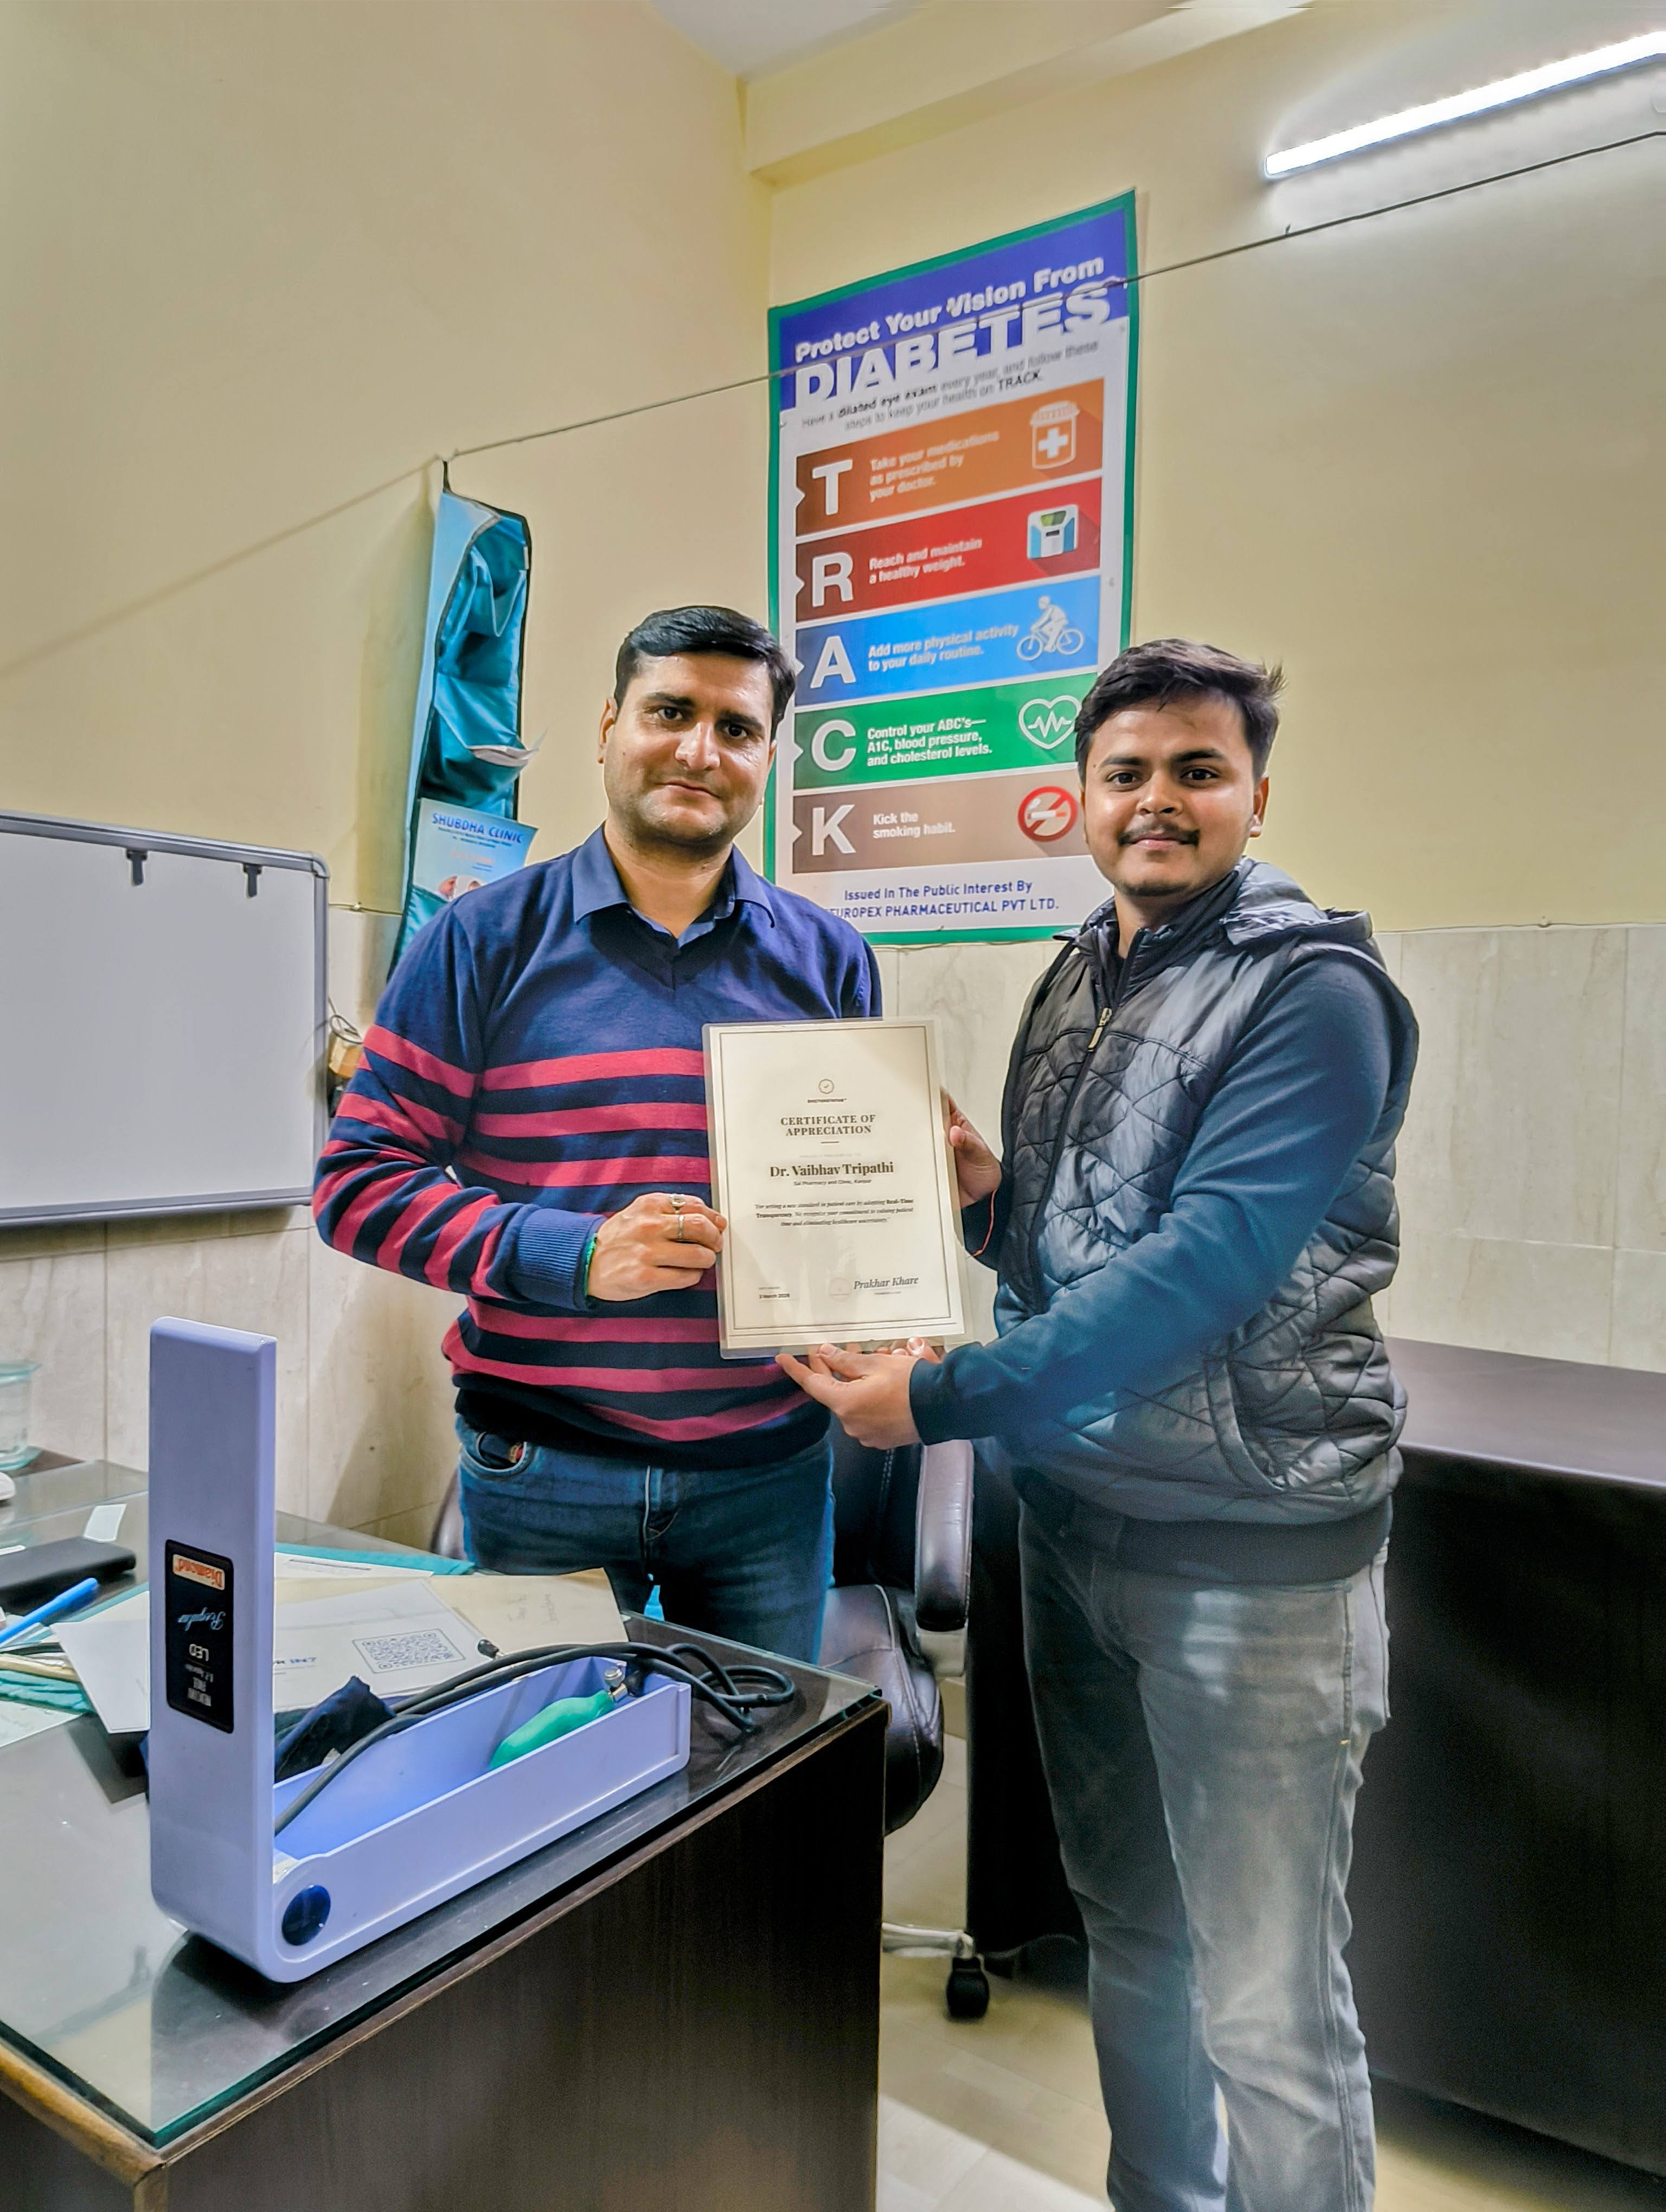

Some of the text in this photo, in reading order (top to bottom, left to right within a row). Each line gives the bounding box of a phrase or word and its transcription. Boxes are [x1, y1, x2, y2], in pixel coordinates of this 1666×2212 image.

[795, 256, 1104, 363] Protect Your Vision From
[795, 280, 1111, 411] DIABETES
[837, 398, 877, 419] dilated
[881, 394, 901, 410] eye
[905, 384, 938, 402] exam
[941, 376, 975, 394] every
[1003, 360, 1025, 375] and
[1028, 349, 1061, 368] follow
[1065, 341, 1098, 358] these
[875, 411, 887, 423] to
[889, 404, 913, 421] keep
[915, 397, 940, 415] your
[942, 386, 977, 406] health
[979, 384, 995, 397] on
[870, 432, 1000, 472] Take your medications
[870, 455, 964, 486] as prescribed by
[811, 459, 853, 516] T
[870, 476, 937, 503] your doctor.
[870, 538, 983, 570] Reach and maintain
[812, 551, 854, 607] R
[870, 555, 965, 584] a healthy weight.
[869, 625, 1019, 658] Add more physical activity
[810, 635, 856, 689] A
[868, 645, 984, 671] to your daily routine.
[811, 719, 856, 772] C
[867, 732, 983, 753] A1C, blood pressure,
[868, 724, 907, 740] Control
[909, 723, 935, 738] your
[867, 742, 992, 767] and cholesterol levels.
[432, 813, 485, 834] SHUBDHA
[489, 827, 523, 844] CLINIC
[811, 803, 856, 856] K
[873, 812, 919, 825] Kick the
[873, 821, 956, 839] smoking habit.
[844, 880, 1033, 901] Issued In The Public Interest By
[886, 901, 997, 917] PHARMACEUTICAL
[1001, 899, 1027, 911] PVT
[1029, 898, 1059, 911] LTD.
[781, 1114, 876, 1126] CERTIFICATE OF
[786, 1125, 872, 1136] APPRECIATION
[770, 1161, 894, 1177] Dr. Vaibhav Tripathi
[854, 1276, 919, 1289] Prakhar Khare
[189, 1643, 209, 1662] LED
